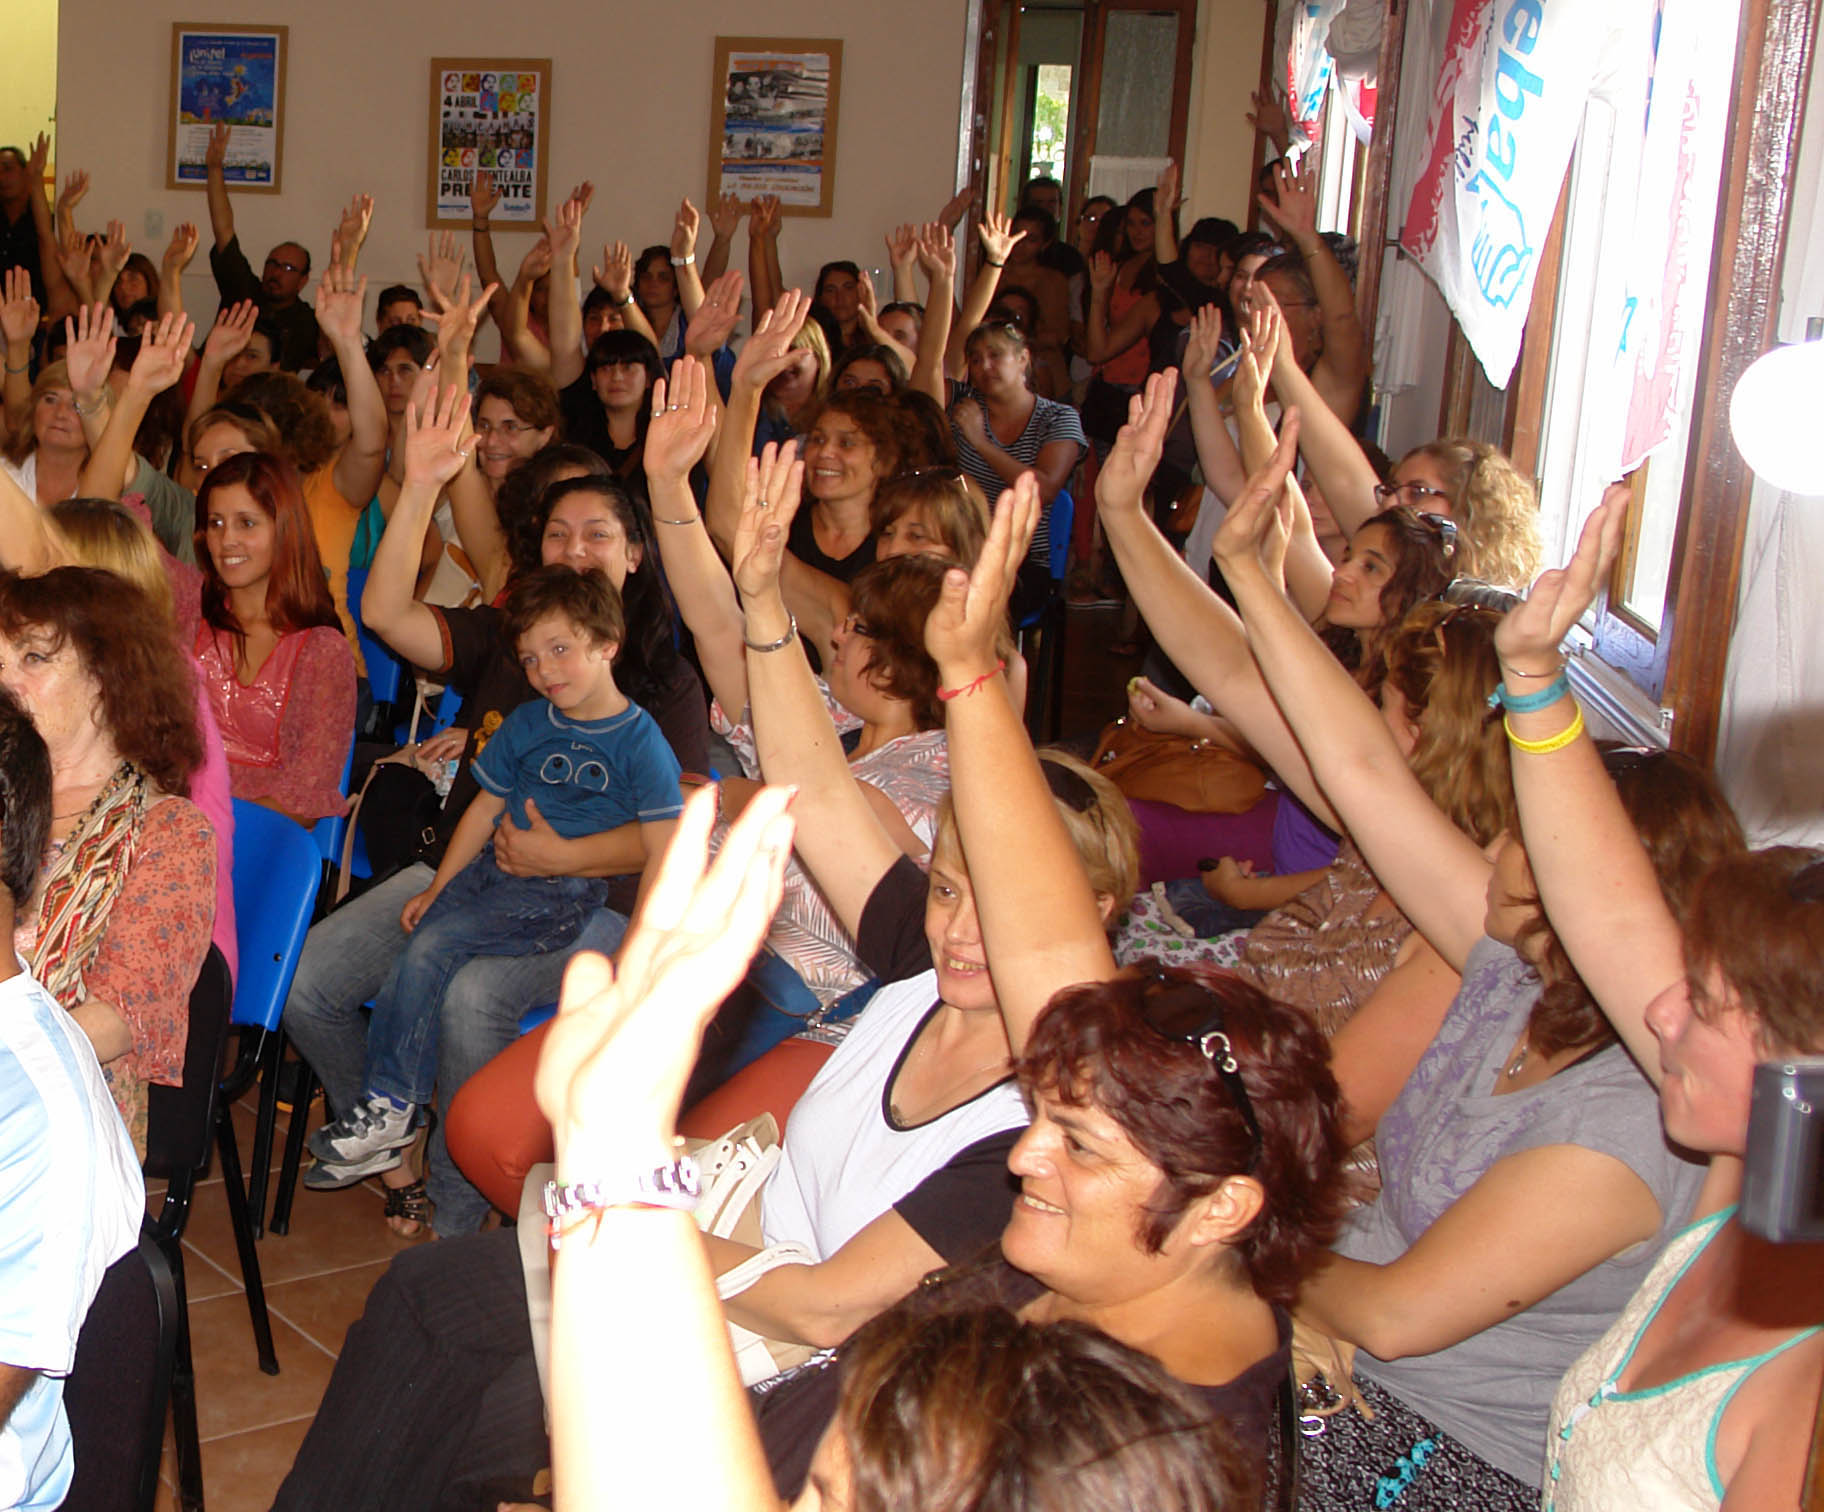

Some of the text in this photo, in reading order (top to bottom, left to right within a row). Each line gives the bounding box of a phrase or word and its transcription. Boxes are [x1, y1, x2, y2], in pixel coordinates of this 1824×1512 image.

[443, 94, 478, 108] 4 ABRIL
[441, 168, 475, 182] CARLOS
[440, 182, 532, 198] PREENTE
